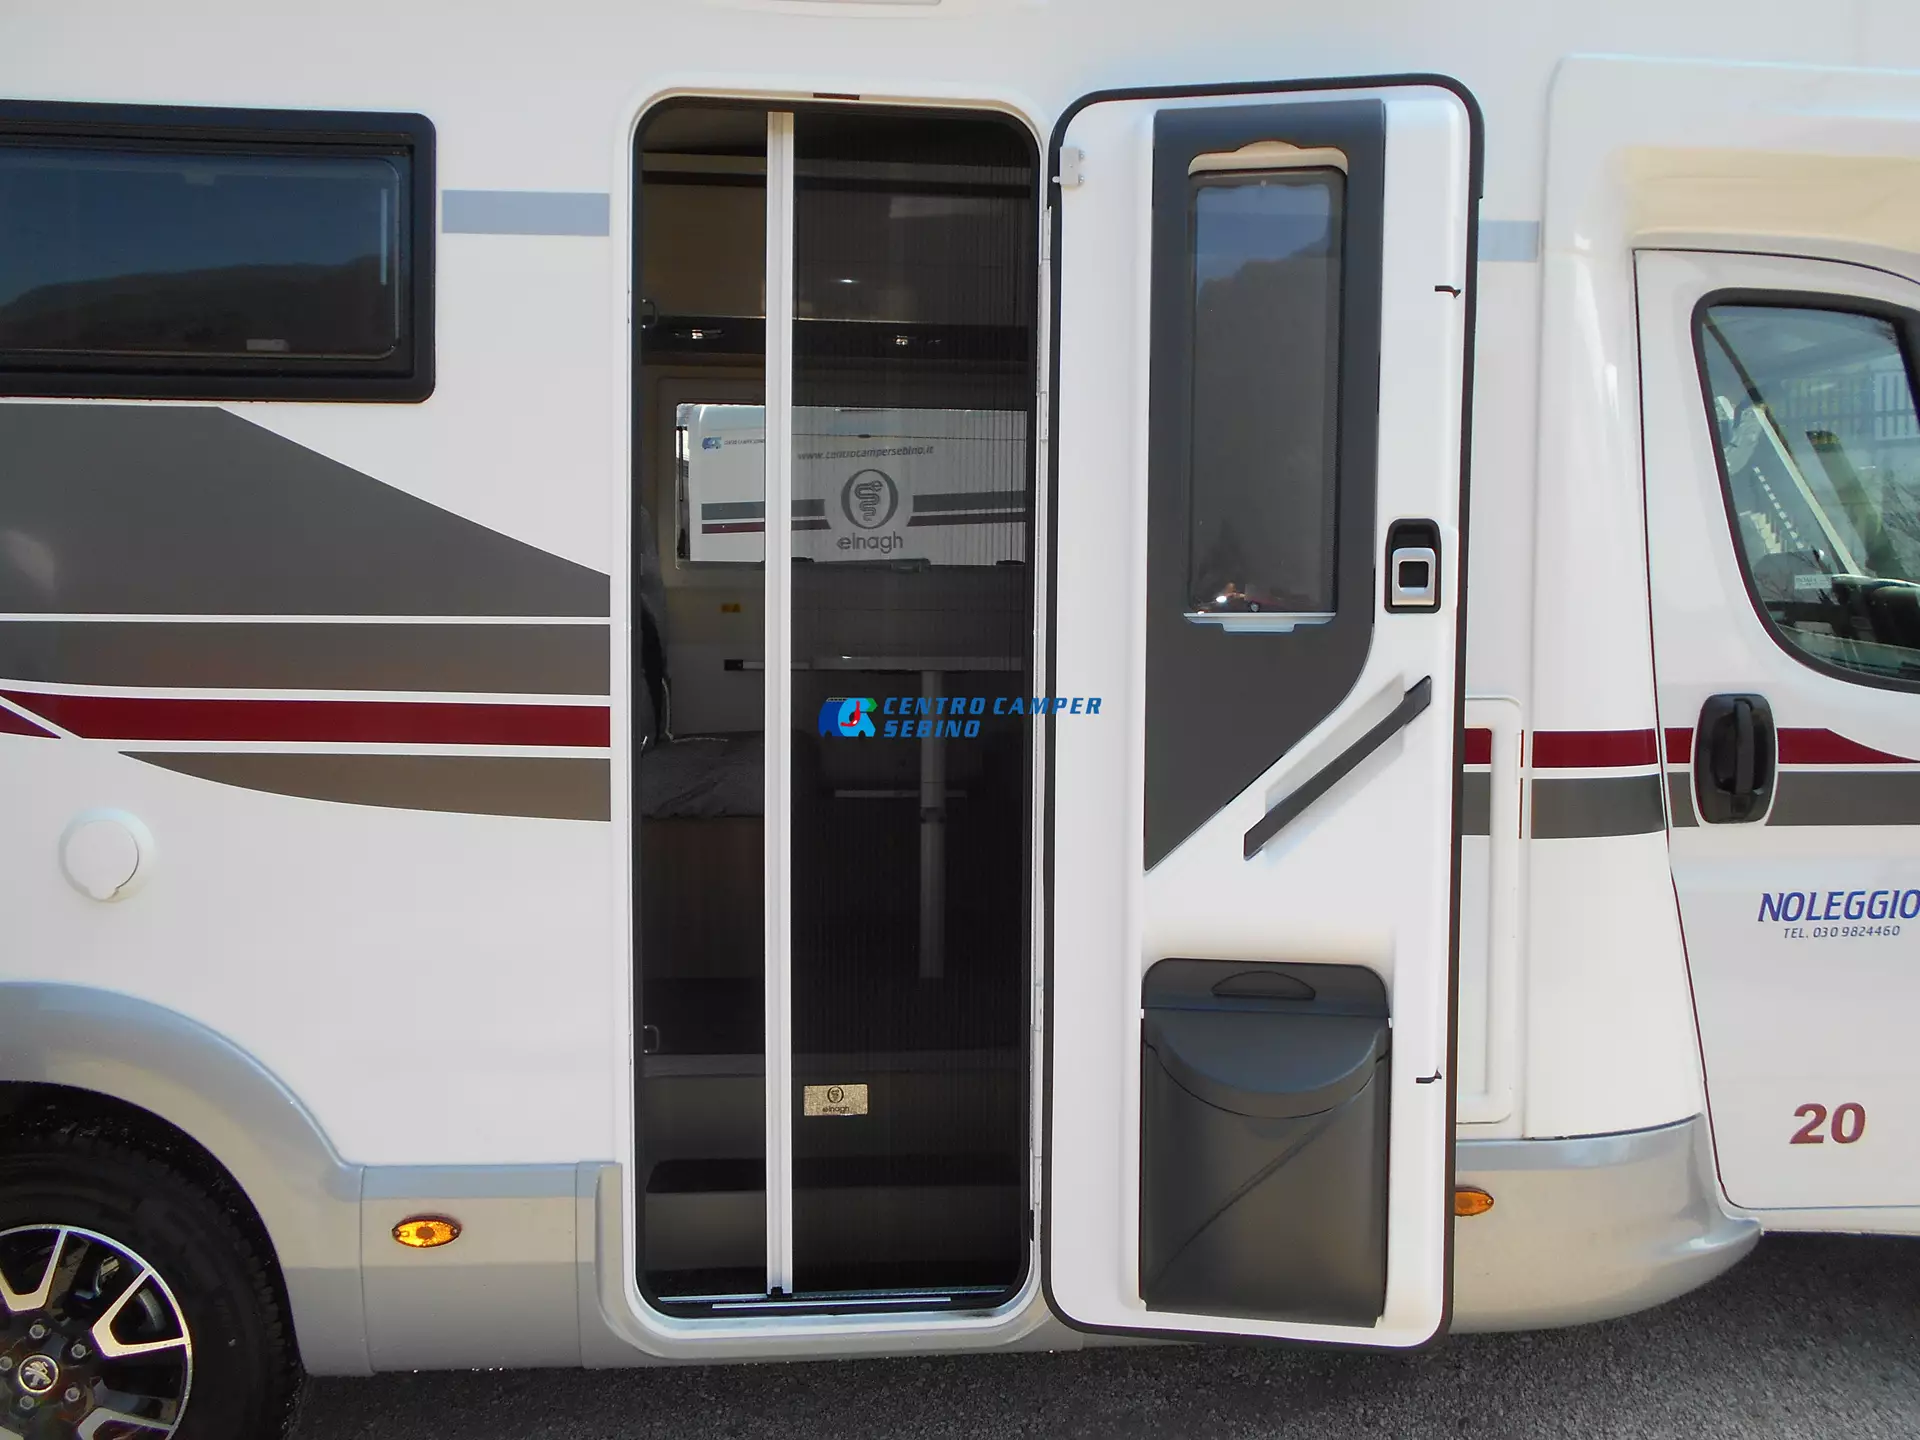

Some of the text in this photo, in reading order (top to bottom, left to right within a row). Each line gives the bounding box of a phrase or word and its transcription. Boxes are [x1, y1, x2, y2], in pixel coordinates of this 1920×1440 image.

[836, 531, 904, 554] elnagh
[1757, 888, 1920, 922] NOLEGGIO
[1783, 925, 1901, 939] TEL. 030 9824460
[1789, 1102, 1866, 1145] 20
